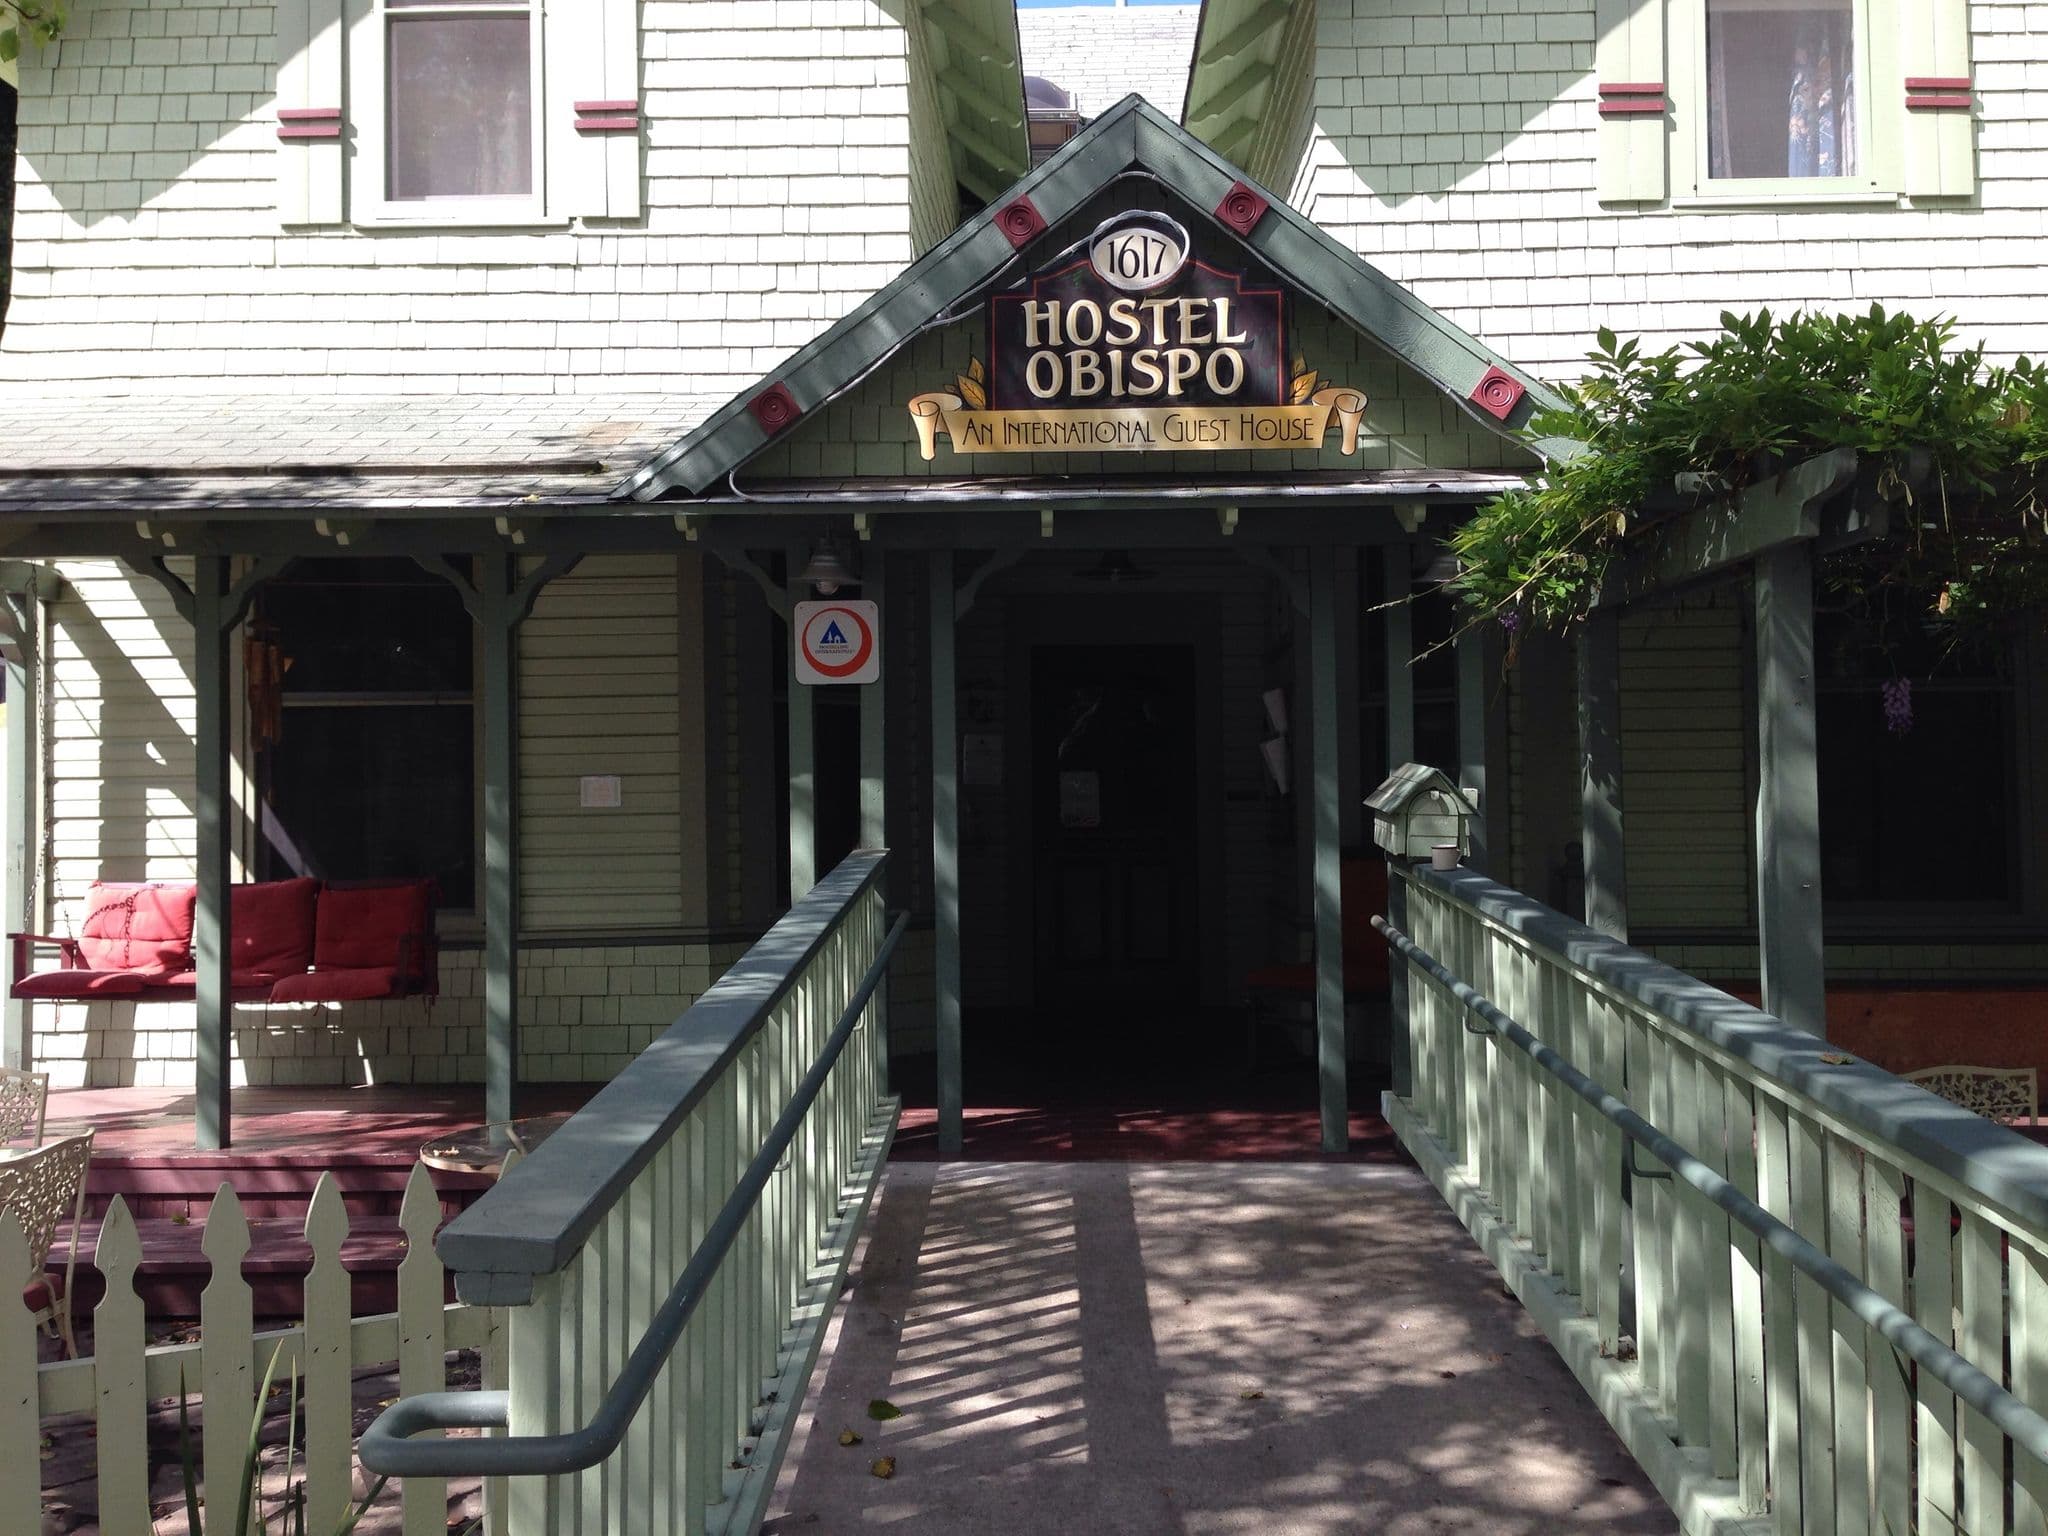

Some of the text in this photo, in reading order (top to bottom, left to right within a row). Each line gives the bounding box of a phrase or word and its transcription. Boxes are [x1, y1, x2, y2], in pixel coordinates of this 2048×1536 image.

[1109, 236, 1167, 279] 1617
[1022, 296, 1249, 348] HOSTEL
[1025, 347, 1245, 400] OBISPO
